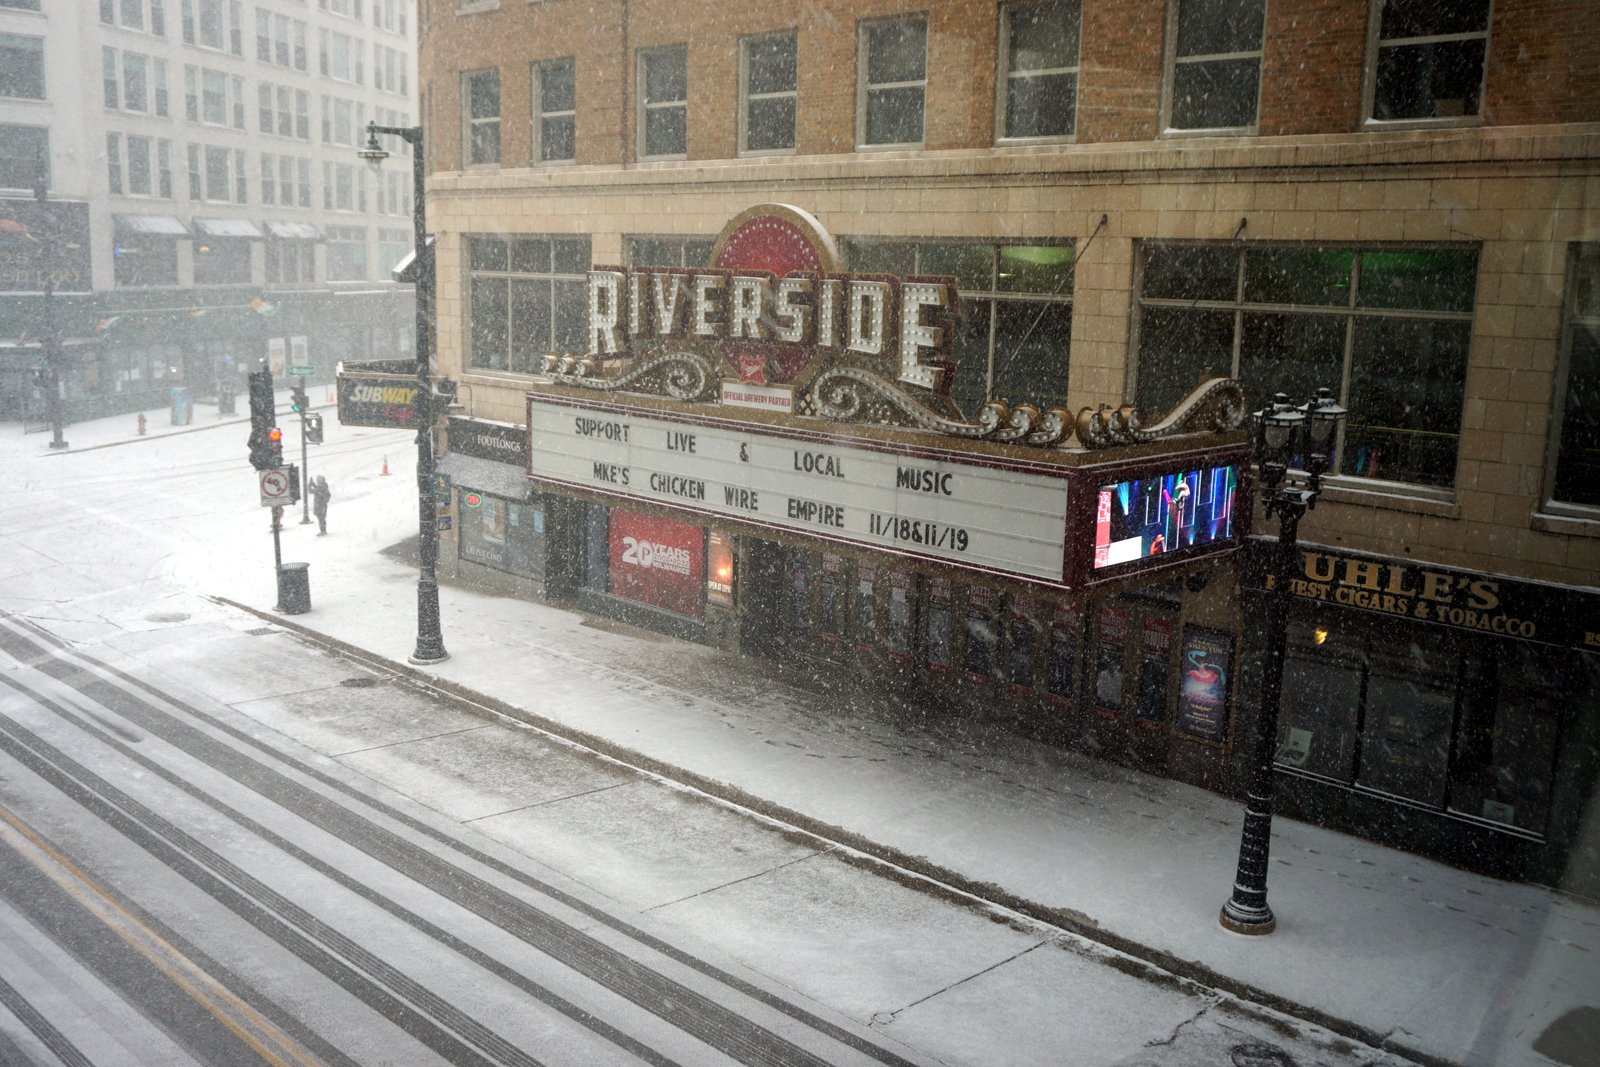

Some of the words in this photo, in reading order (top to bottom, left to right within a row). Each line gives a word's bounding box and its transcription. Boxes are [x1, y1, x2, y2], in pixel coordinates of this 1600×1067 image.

[585, 268, 949, 389] RIVERSIDE
[348, 384, 418, 404] SUBWAY
[723, 390, 744, 402] OFFICIAL
[744, 392, 768, 405] BREWERY
[768, 395, 791, 408] PARTNER
[477, 434, 521, 453] FOOTLONGS
[575, 416, 630, 442] SUPPORT
[666, 431, 697, 454] LIVE
[739, 442, 750, 463] &
[793, 450, 845, 479] LOCAL
[896, 466, 953, 496] MUSIC
[593, 461, 630, 486] MKE'S
[649, 472, 706, 501] CHICKEN
[724, 485, 759, 511] WIRE
[787, 497, 845, 529] EMPIRE
[621, 536, 654, 568] 20
[651, 542, 691, 561] YEARS
[1304, 552, 1501, 610] UHLE'S
[1335, 587, 1409, 616] CIGARS
[1414, 601, 1430, 619] &
[1435, 605, 1537, 638] TOBACCO
